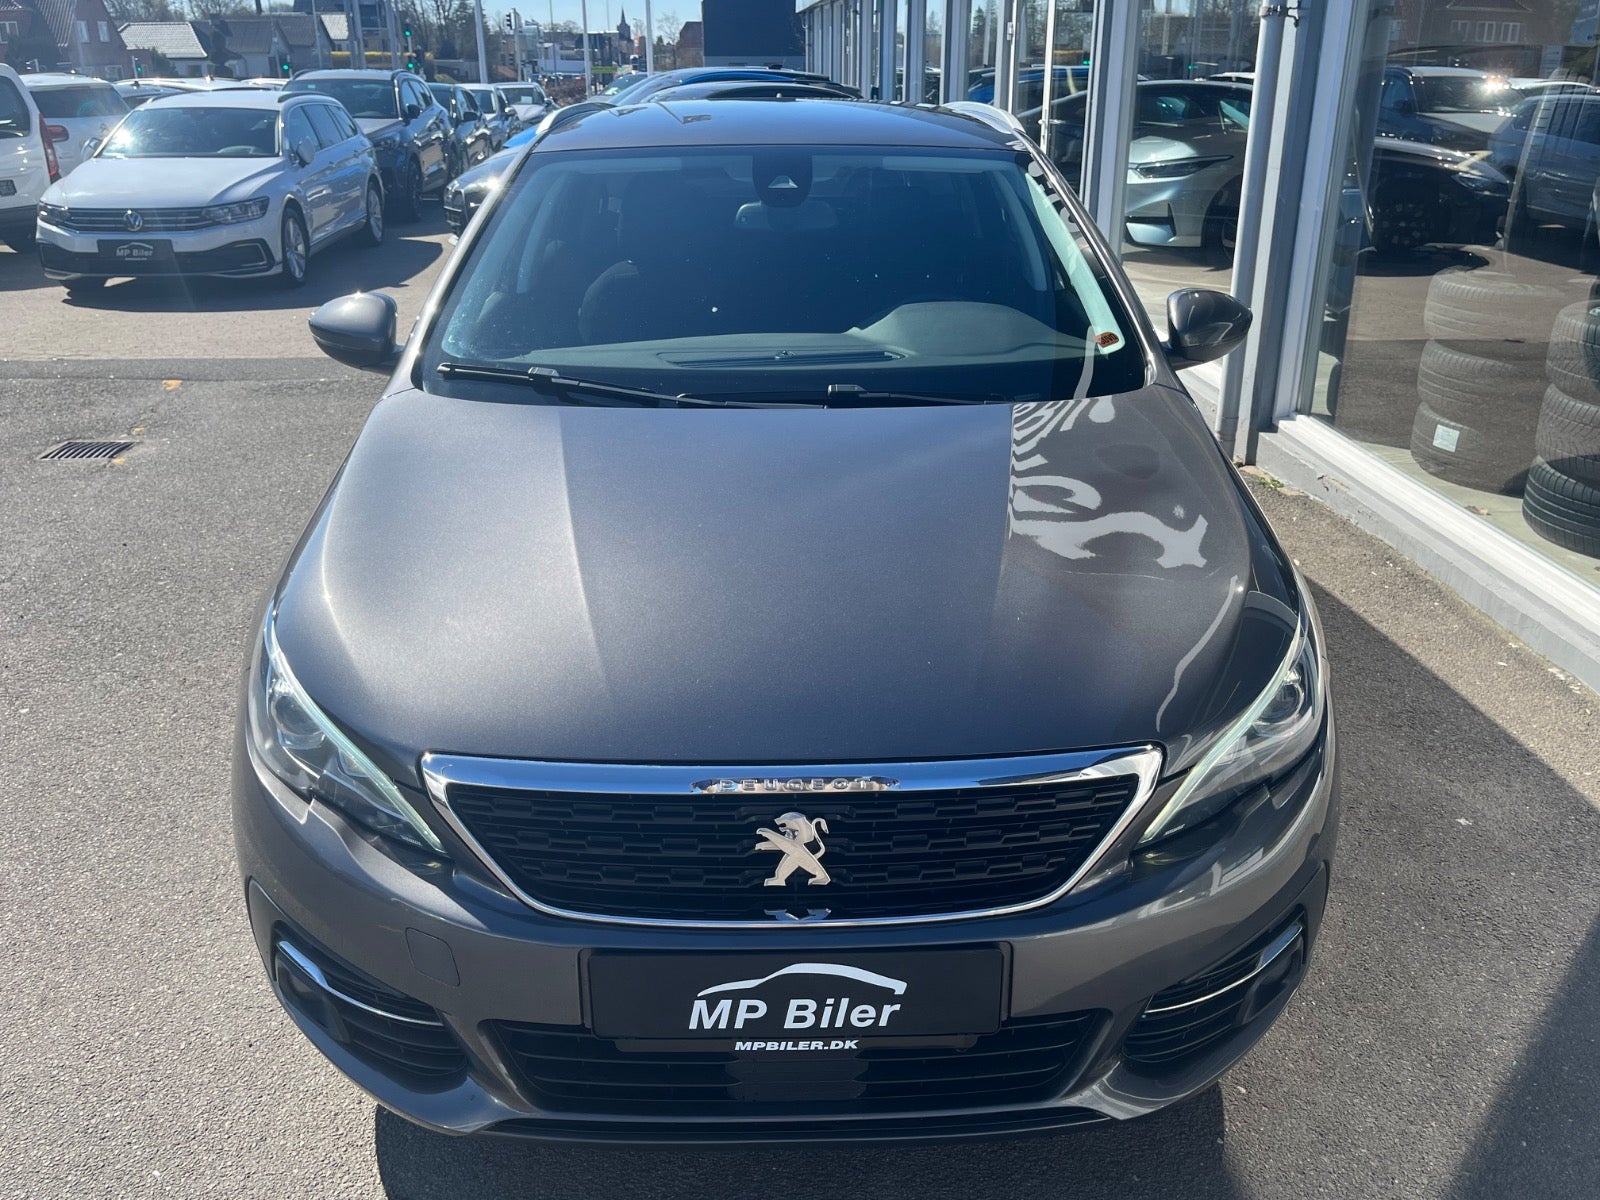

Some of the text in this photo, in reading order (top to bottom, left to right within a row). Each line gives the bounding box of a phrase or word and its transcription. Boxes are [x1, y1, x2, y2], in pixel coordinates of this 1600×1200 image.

[718, 777, 871, 791] PEUGEOT
[688, 997, 901, 1030] MP Biler
[734, 1039, 860, 1051] MPBILER.DK
